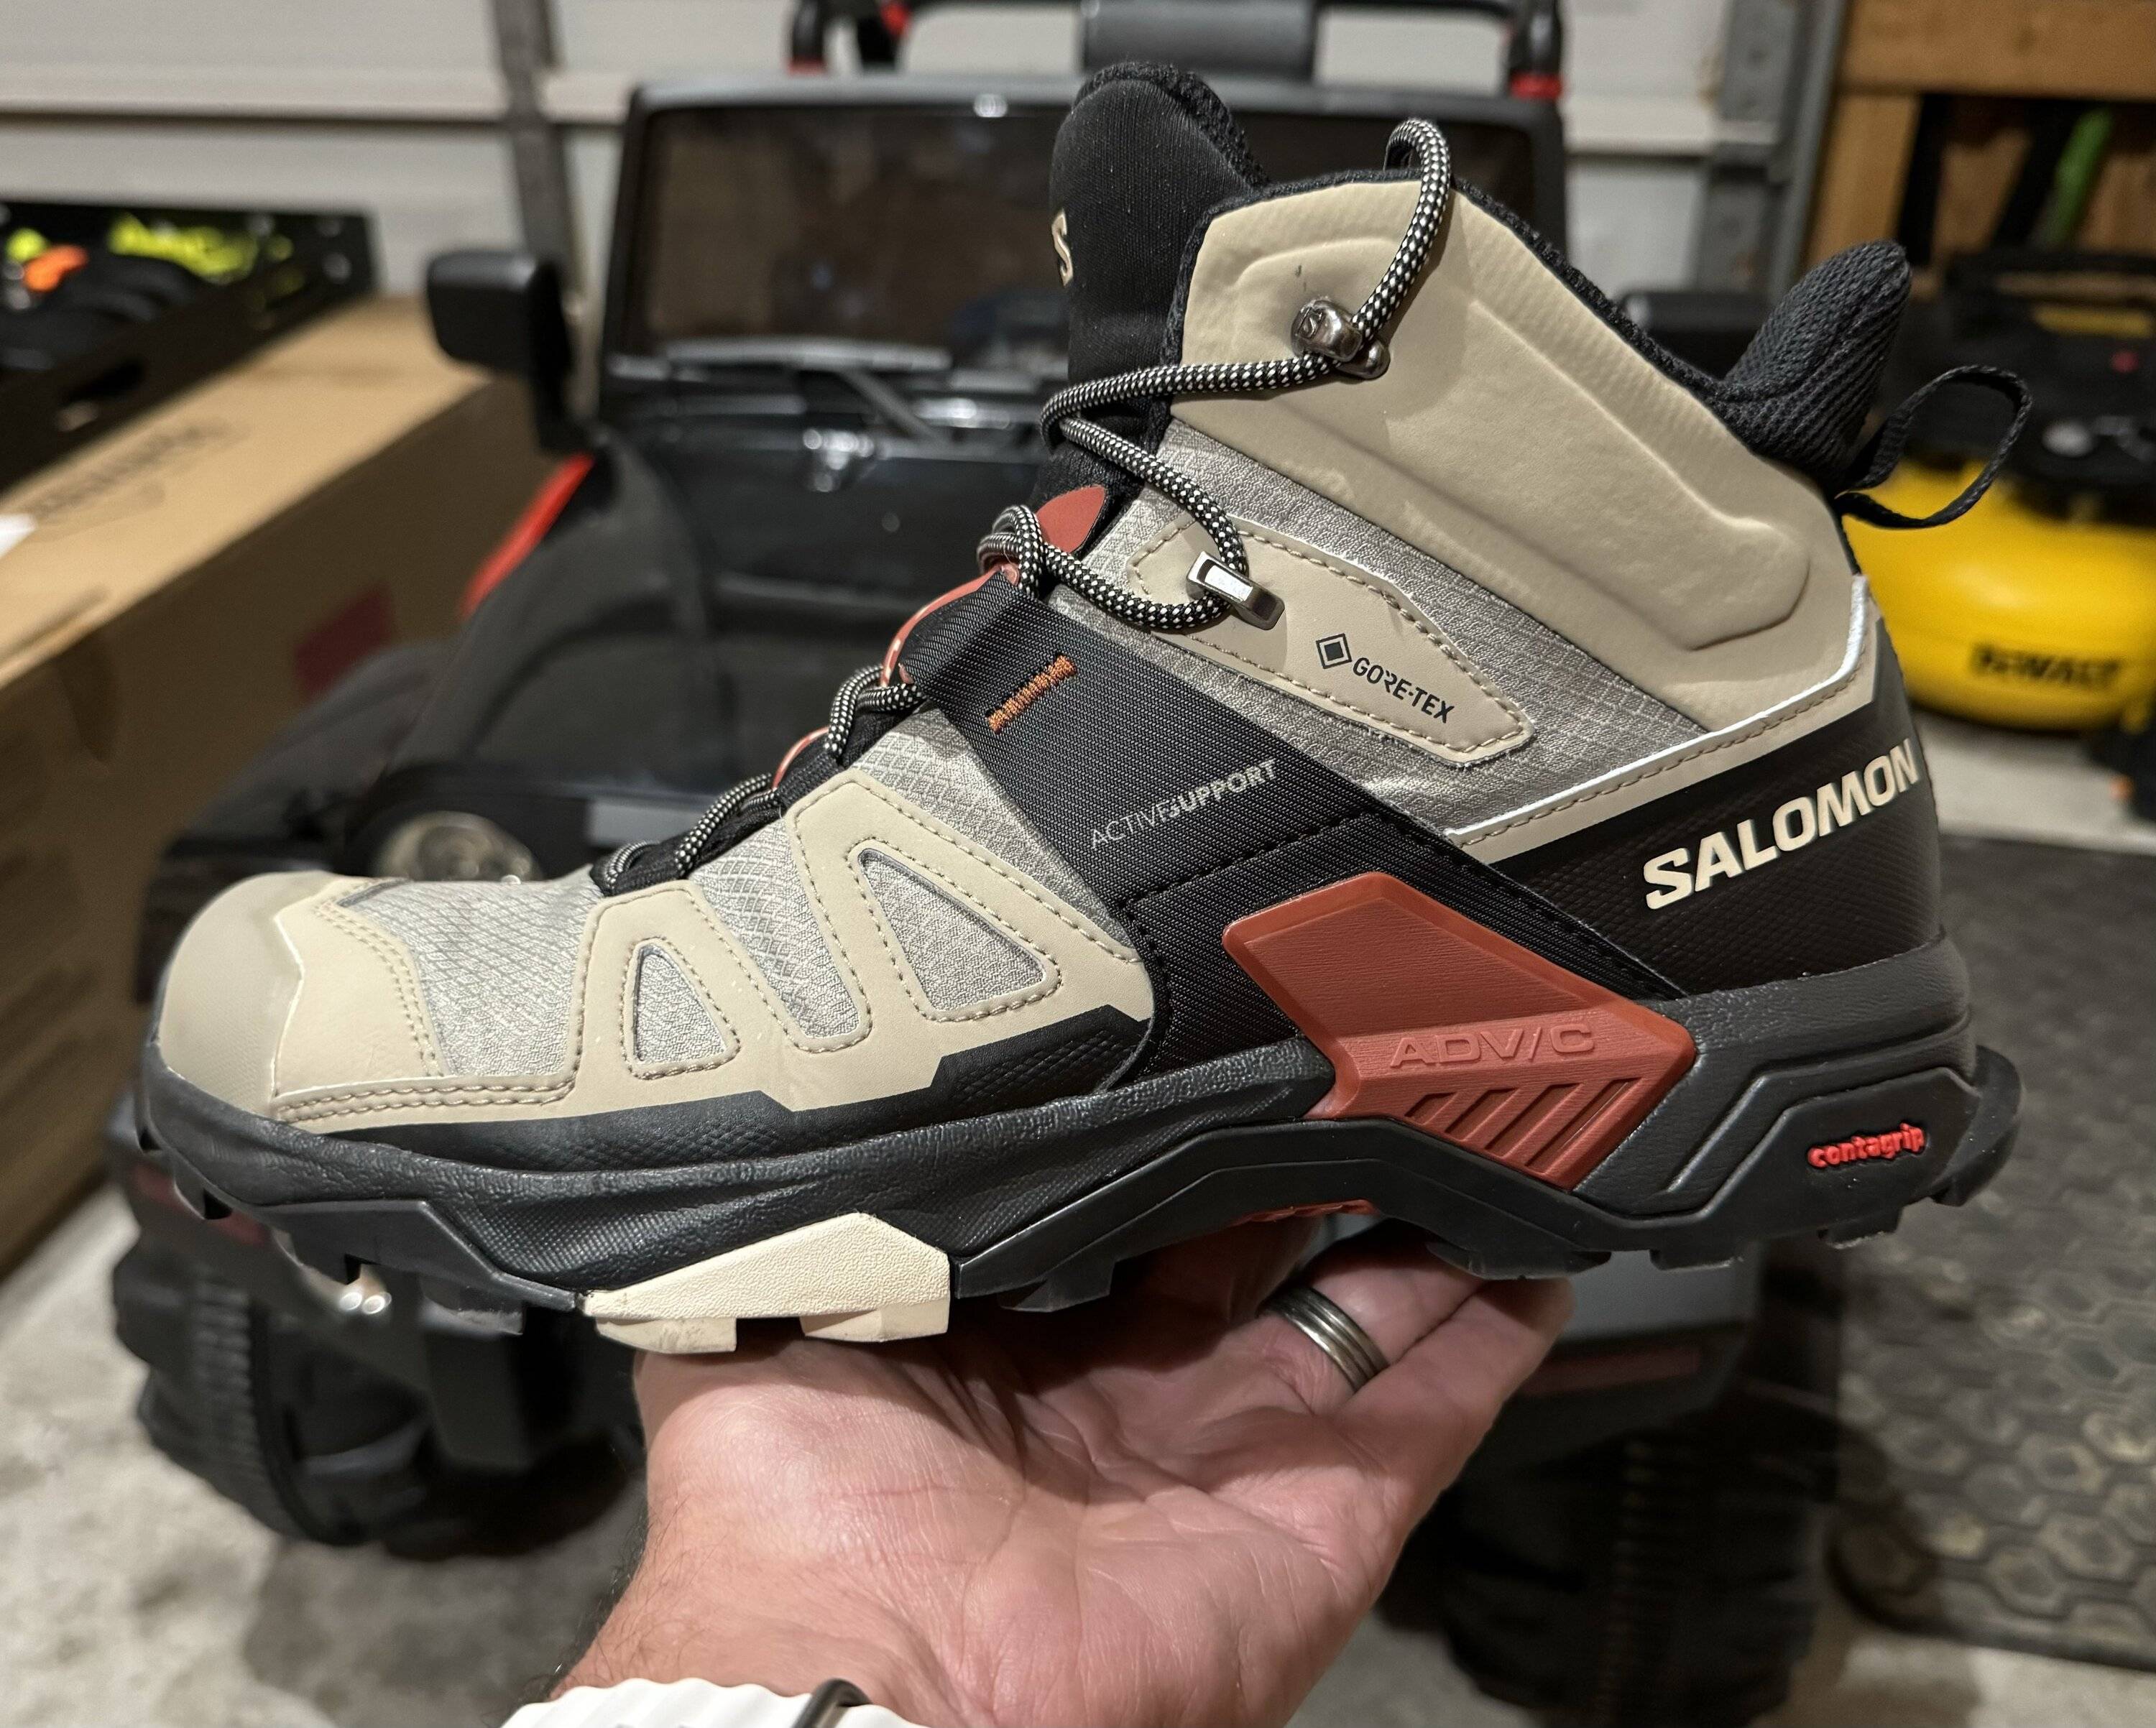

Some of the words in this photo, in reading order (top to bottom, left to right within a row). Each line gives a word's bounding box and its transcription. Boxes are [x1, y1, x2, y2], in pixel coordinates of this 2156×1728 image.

[1353, 657, 1455, 724] GORE-TEX
[1643, 737, 1920, 910] SALOMON
[1390, 1023, 1595, 1068] ADV/C
[1807, 1122, 1925, 1168] contagrip
